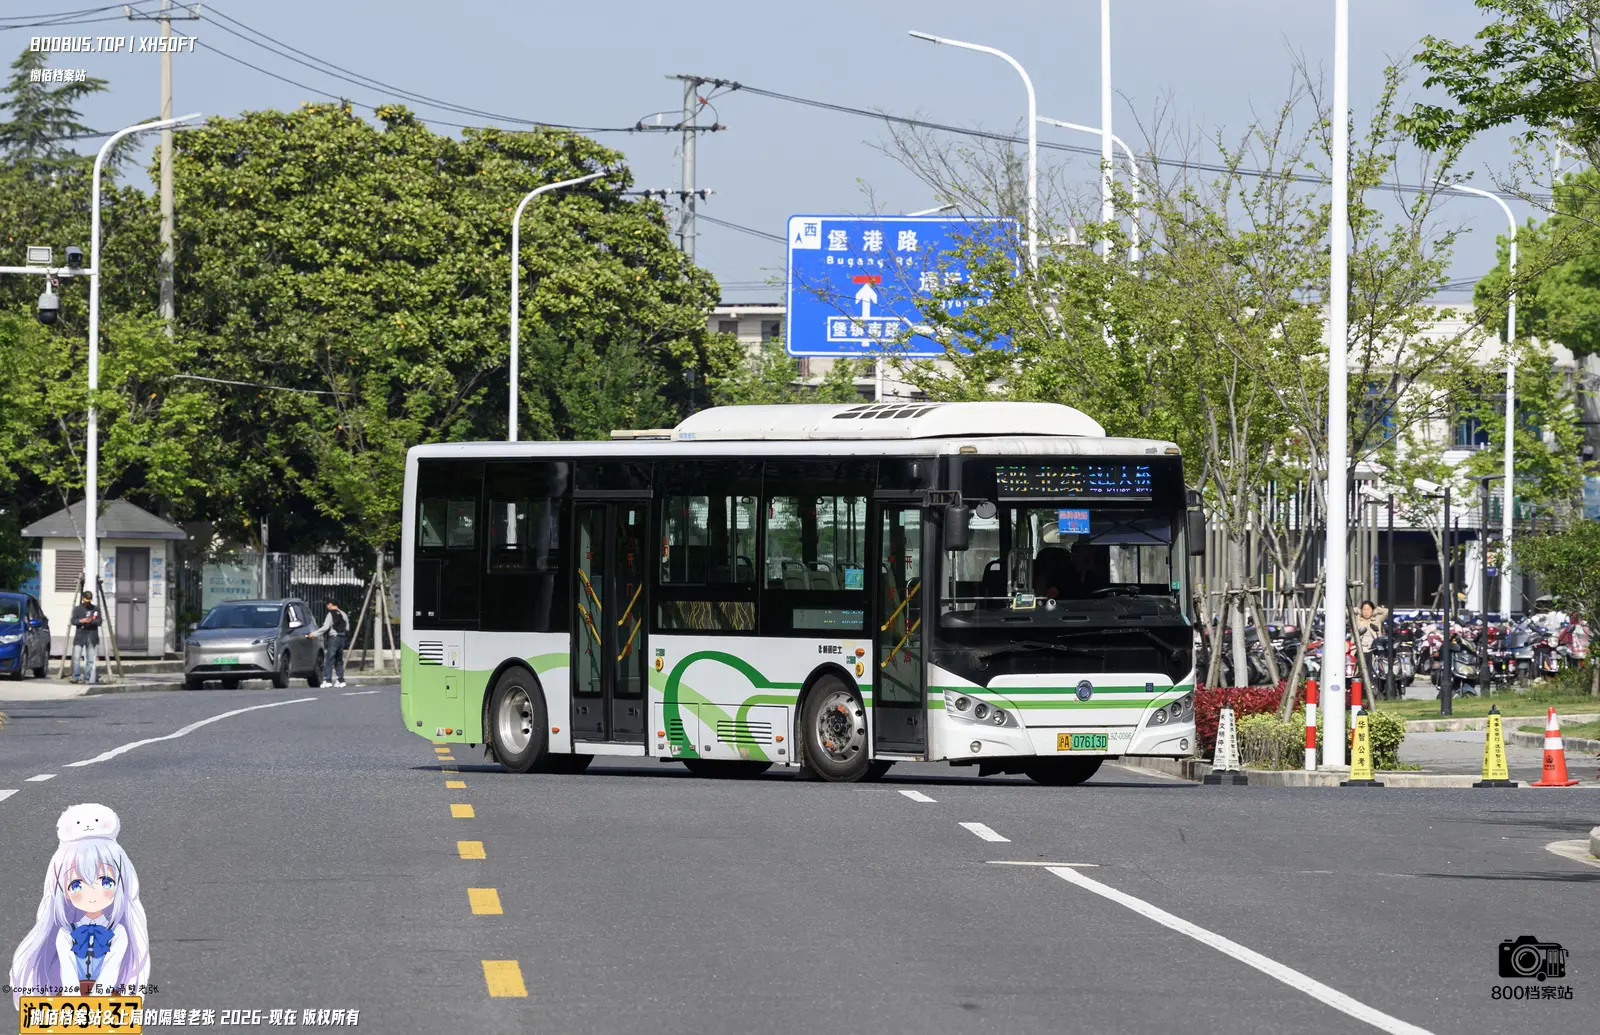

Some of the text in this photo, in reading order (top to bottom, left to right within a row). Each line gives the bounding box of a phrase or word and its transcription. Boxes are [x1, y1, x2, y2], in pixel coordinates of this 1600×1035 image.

[804, 222, 817, 237] 西
[827, 229, 918, 252] 堡港路
[826, 255, 884, 268] Bugang
[1357, 720, 1366, 767] 华智公考
